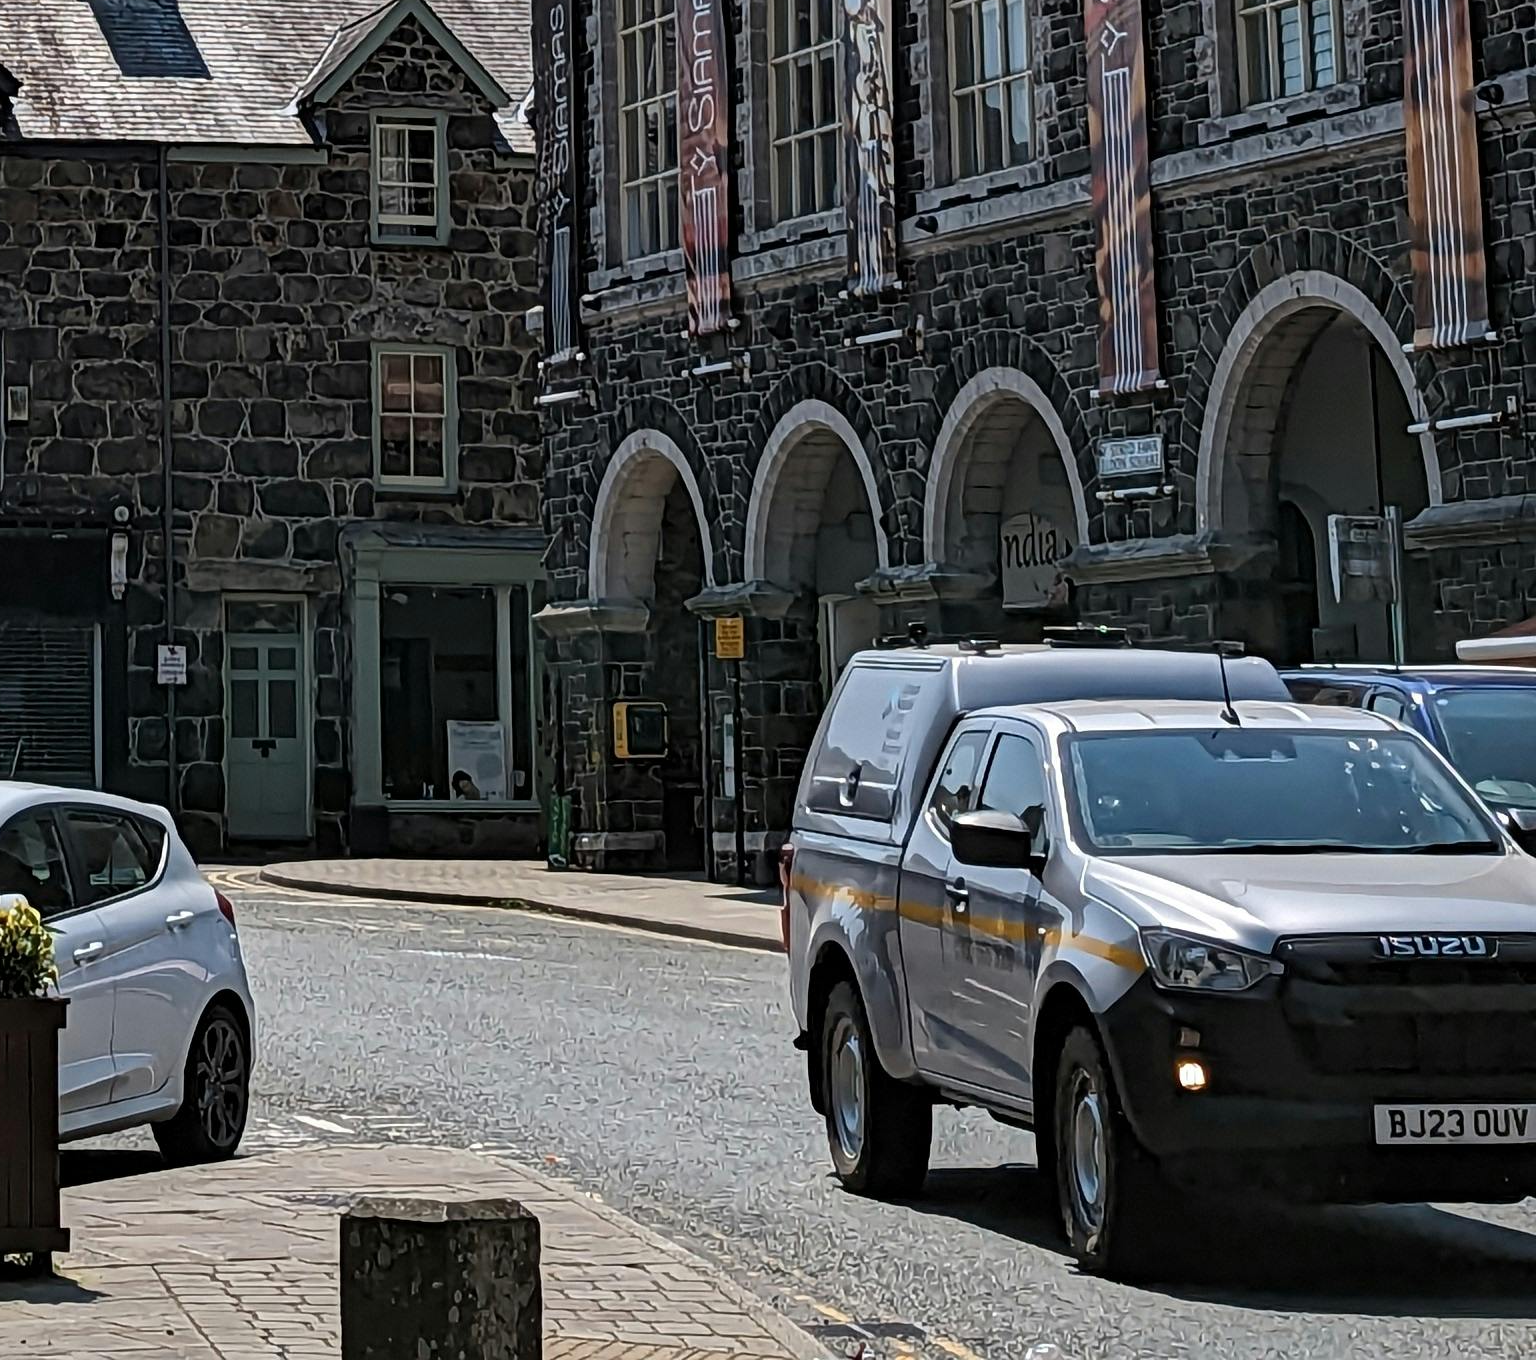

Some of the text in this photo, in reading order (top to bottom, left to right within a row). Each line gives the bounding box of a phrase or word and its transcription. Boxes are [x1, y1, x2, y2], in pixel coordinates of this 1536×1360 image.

[1379, 936, 1487, 956] ISUZU
[1387, 1108, 1529, 1138] BJ23 OUV
